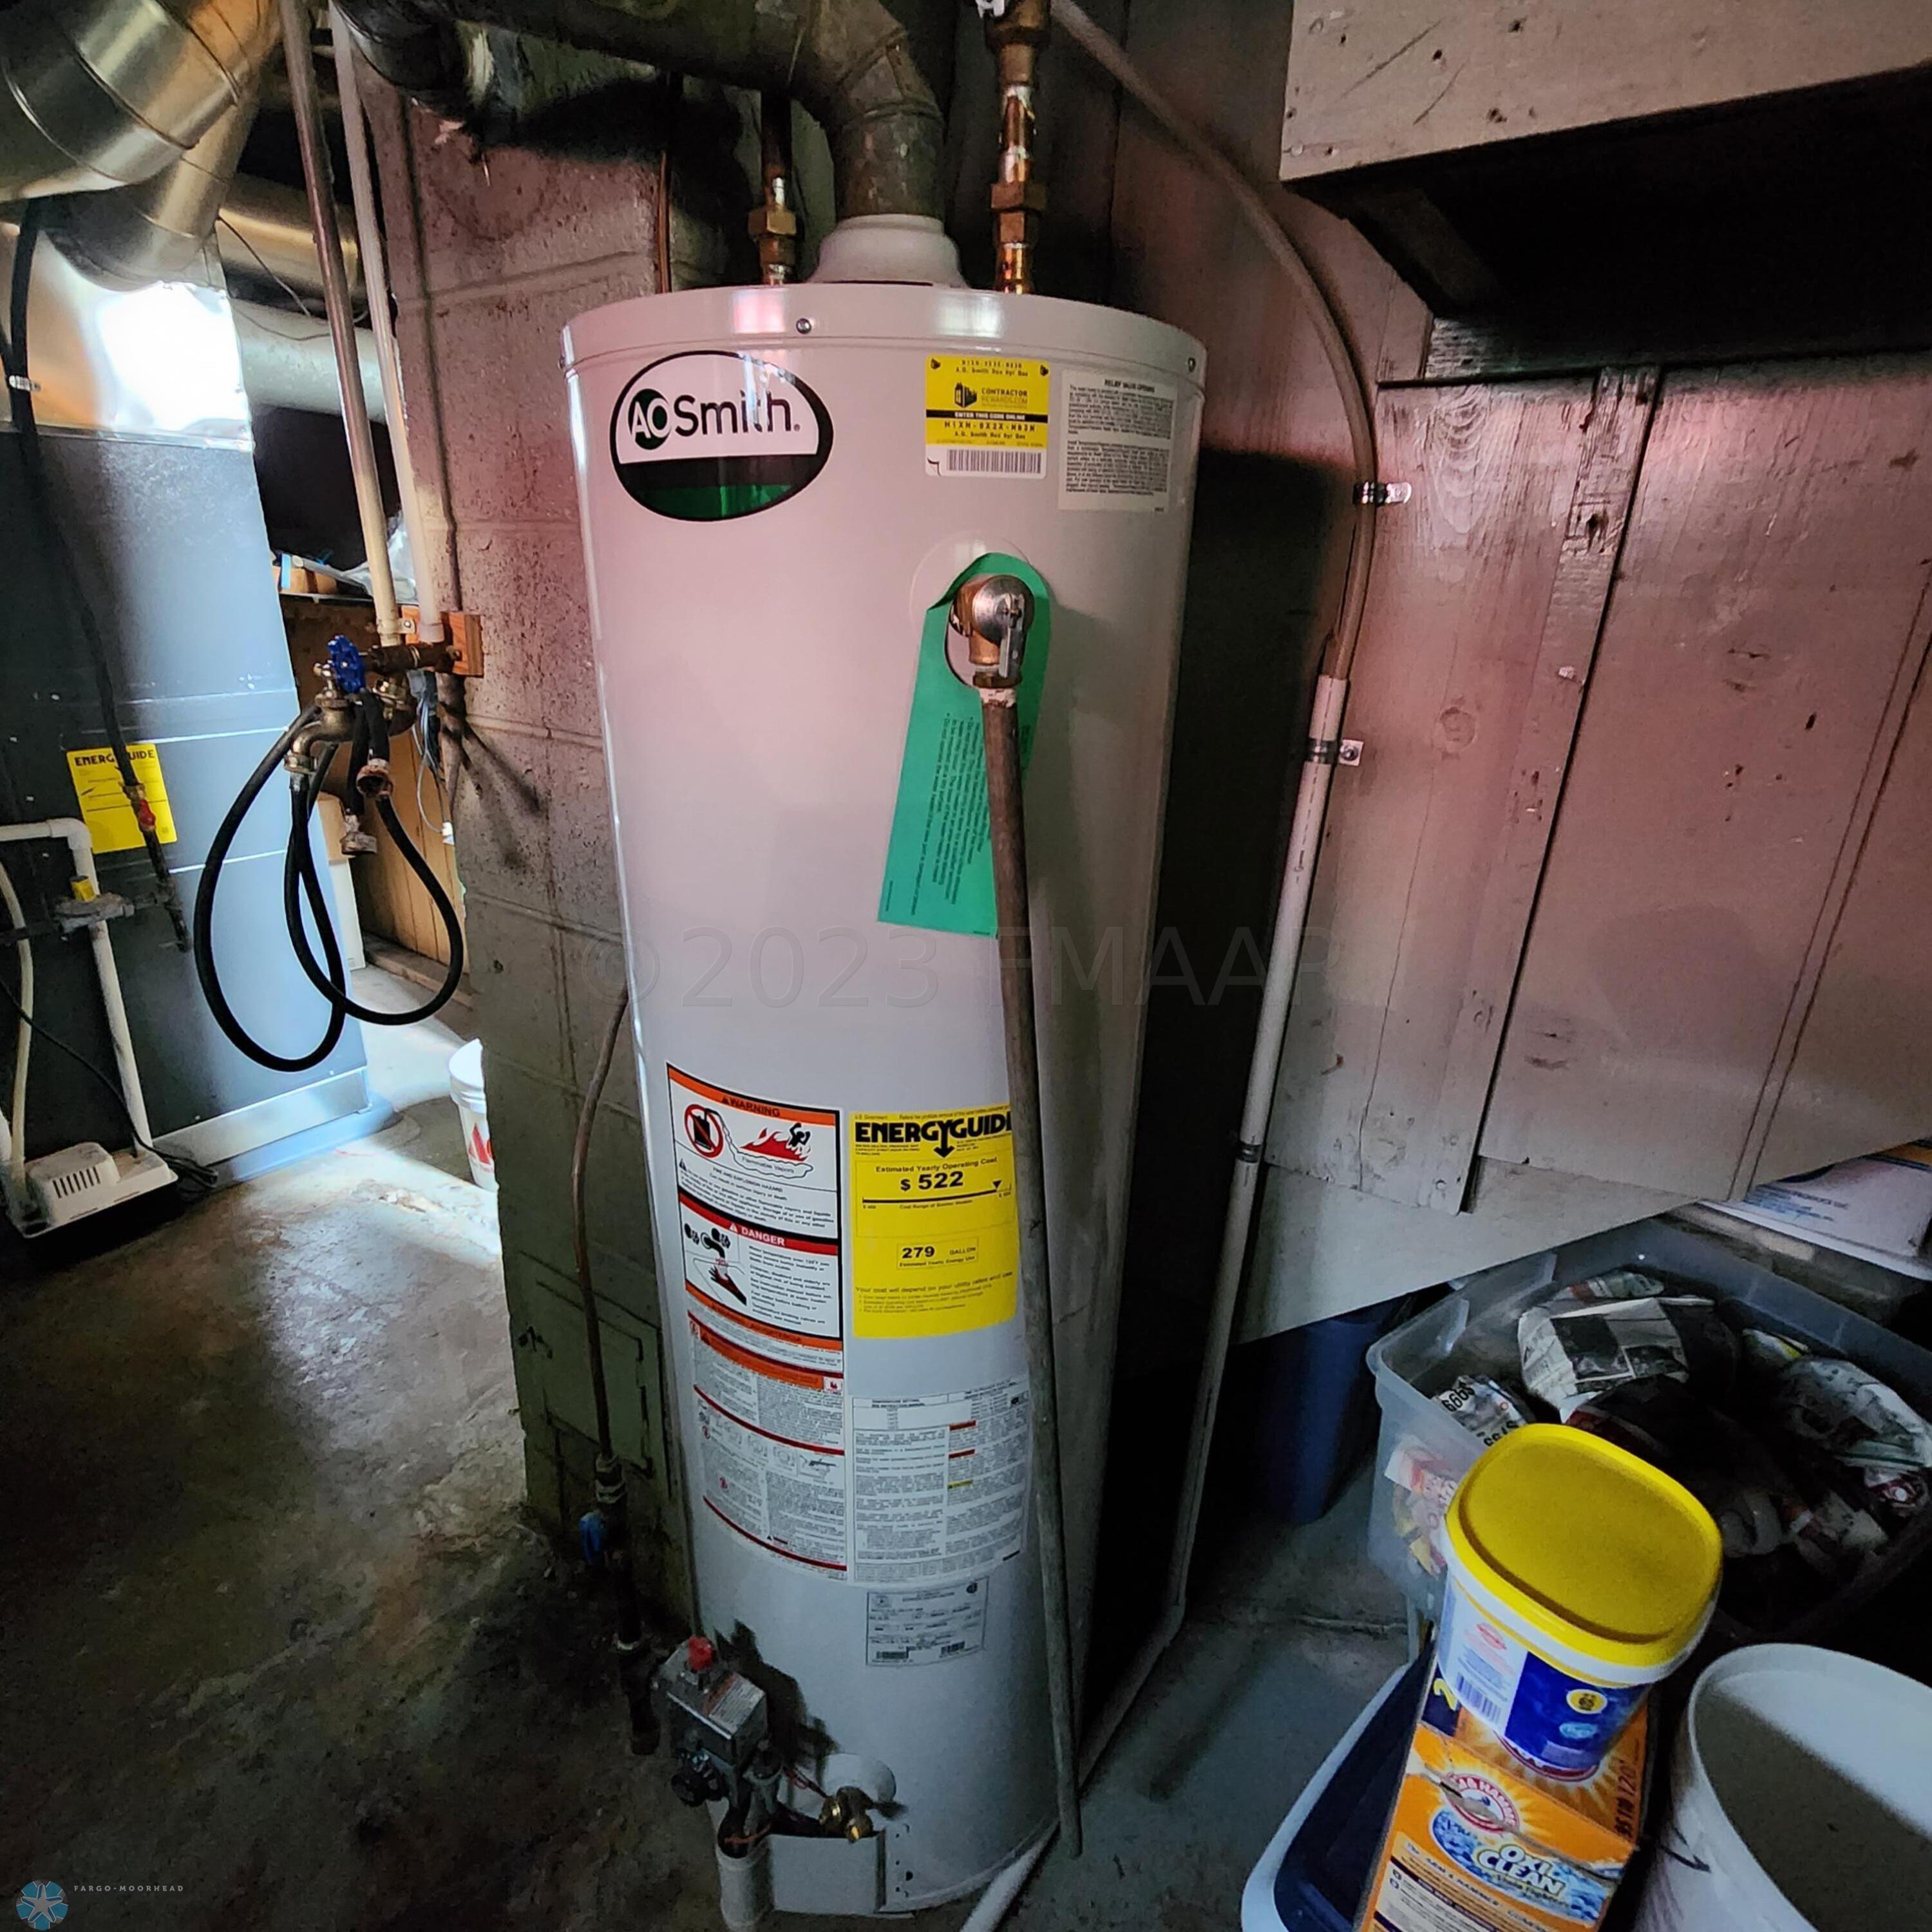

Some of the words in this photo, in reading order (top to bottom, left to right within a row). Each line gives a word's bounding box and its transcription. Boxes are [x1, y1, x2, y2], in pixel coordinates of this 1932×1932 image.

[981, 388, 1027, 397] CONTRACTOR
[75, 750, 155, 766] ENERGUIDE
[728, 1097, 781, 1118] WARNING
[942, 1160, 979, 1170] Operating
[980, 1157, 998, 1165] Cost
[900, 1178, 911, 1191] $
[918, 1170, 965, 1190] 522
[741, 1226, 785, 1246] DANGER
[902, 1245, 935, 1259] 279
[949, 1247, 976, 1255] GALLON
[1499, 1844, 1552, 1875] OXI
[1478, 1849, 1565, 1896] CLEAN
